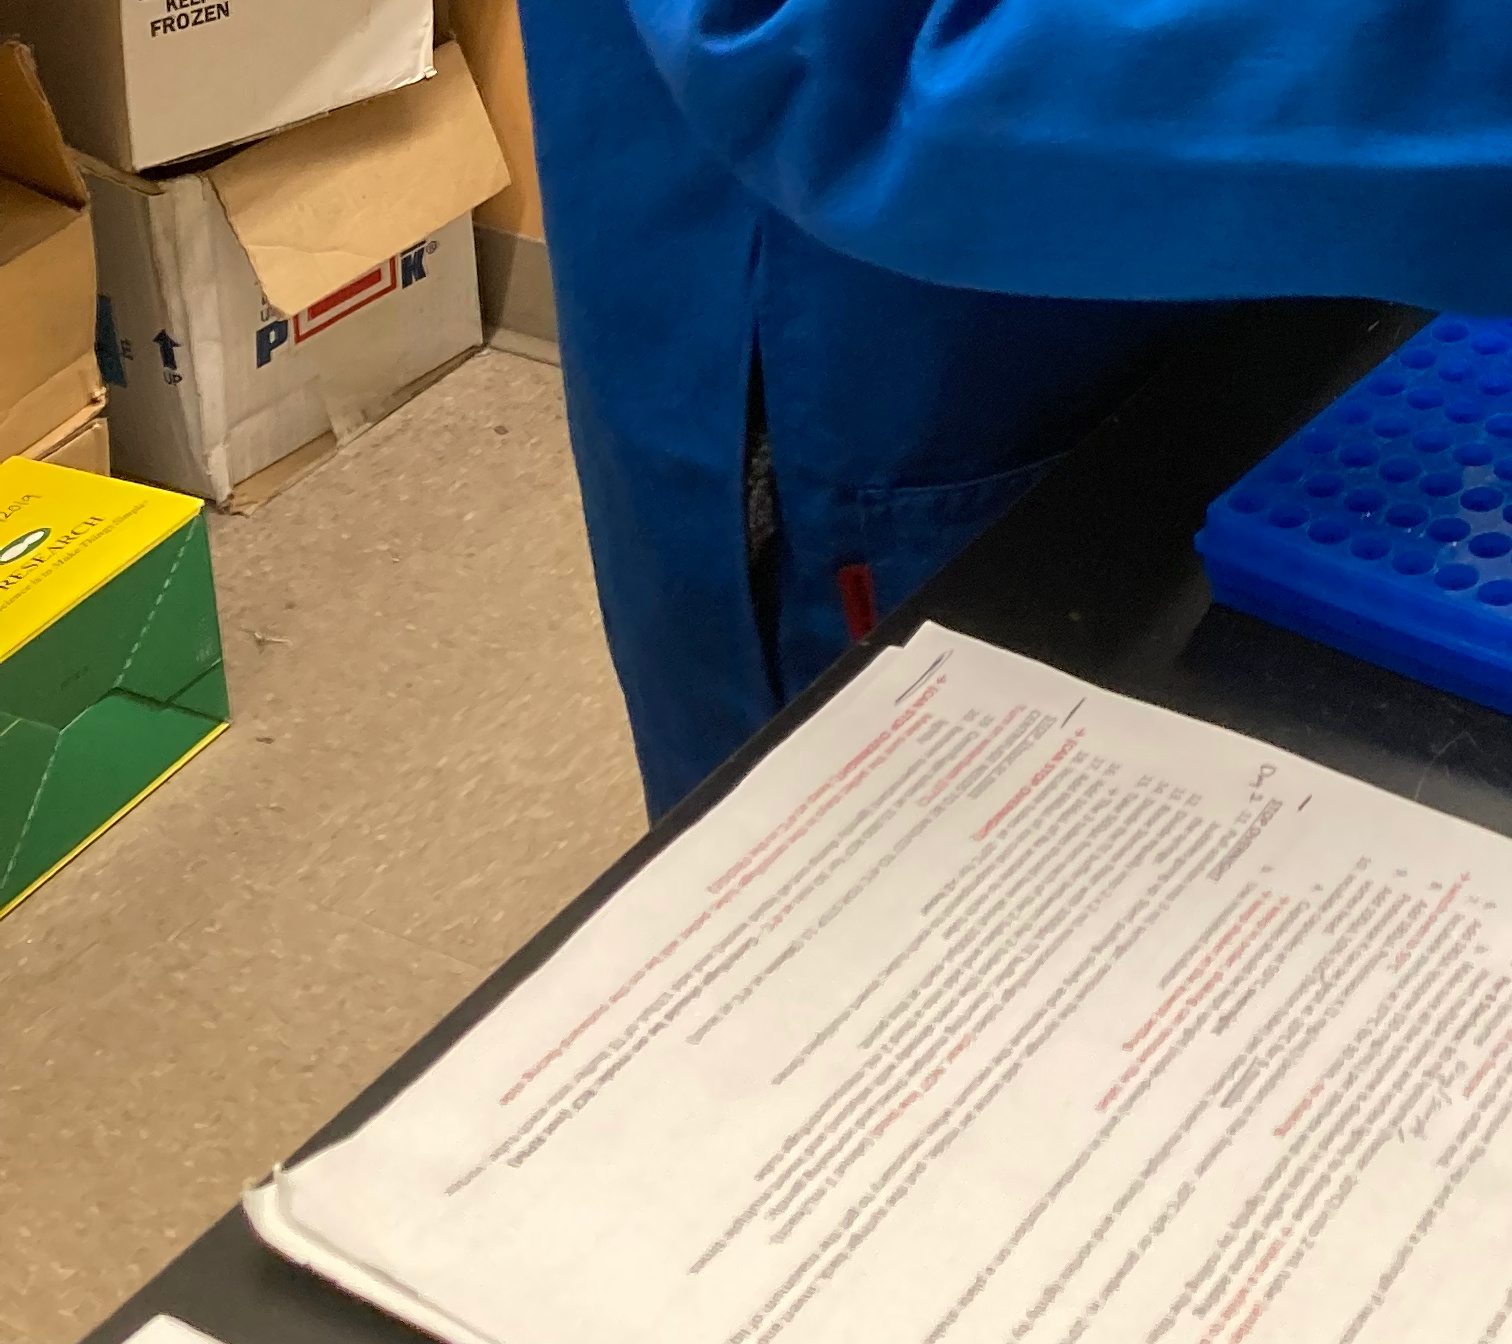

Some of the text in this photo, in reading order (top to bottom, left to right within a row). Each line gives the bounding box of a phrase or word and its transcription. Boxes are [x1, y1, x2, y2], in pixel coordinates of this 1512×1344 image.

[150, 1, 230, 38] FROZEN
[162, 367, 183, 387] UP
[0, 515, 105, 591] RESEARCH
[53, 548, 82, 569] Make
[79, 524, 115, 550] Things
[1253, 798, 1282, 826] STOP
